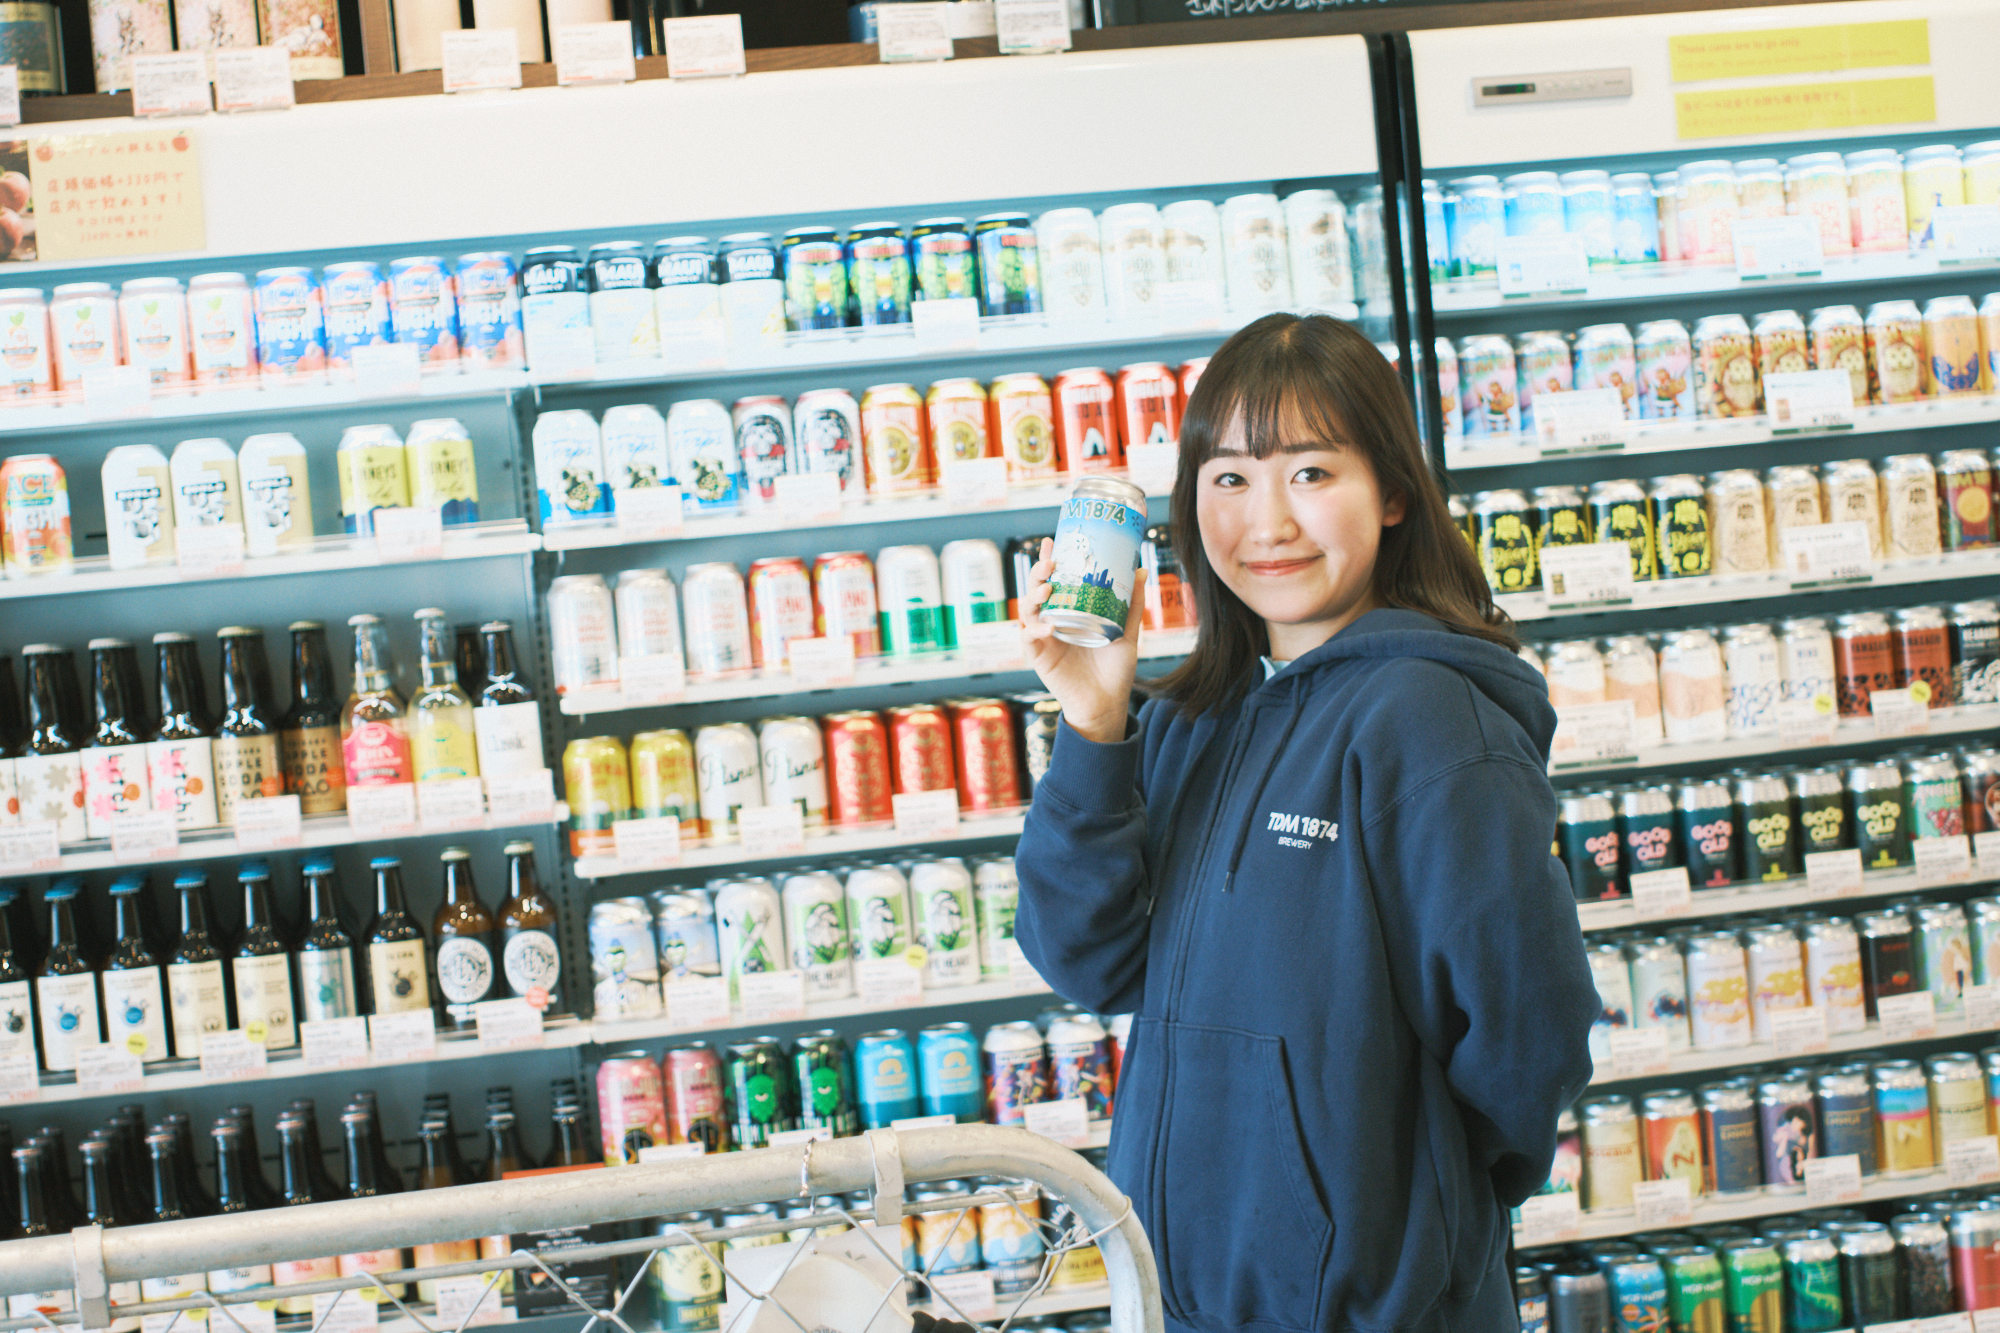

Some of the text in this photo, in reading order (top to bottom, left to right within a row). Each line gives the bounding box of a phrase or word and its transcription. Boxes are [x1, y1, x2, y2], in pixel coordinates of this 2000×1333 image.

[4, 474, 54, 497] ACE
[1083, 499, 1126, 525] 1874
[1051, 593, 1072, 604] IPA
[218, 757, 263, 772] APPLE
[218, 772, 264, 787] SODA
[1267, 811, 1339, 842] TDM 1874
[1278, 836, 1313, 850] BREWERY
